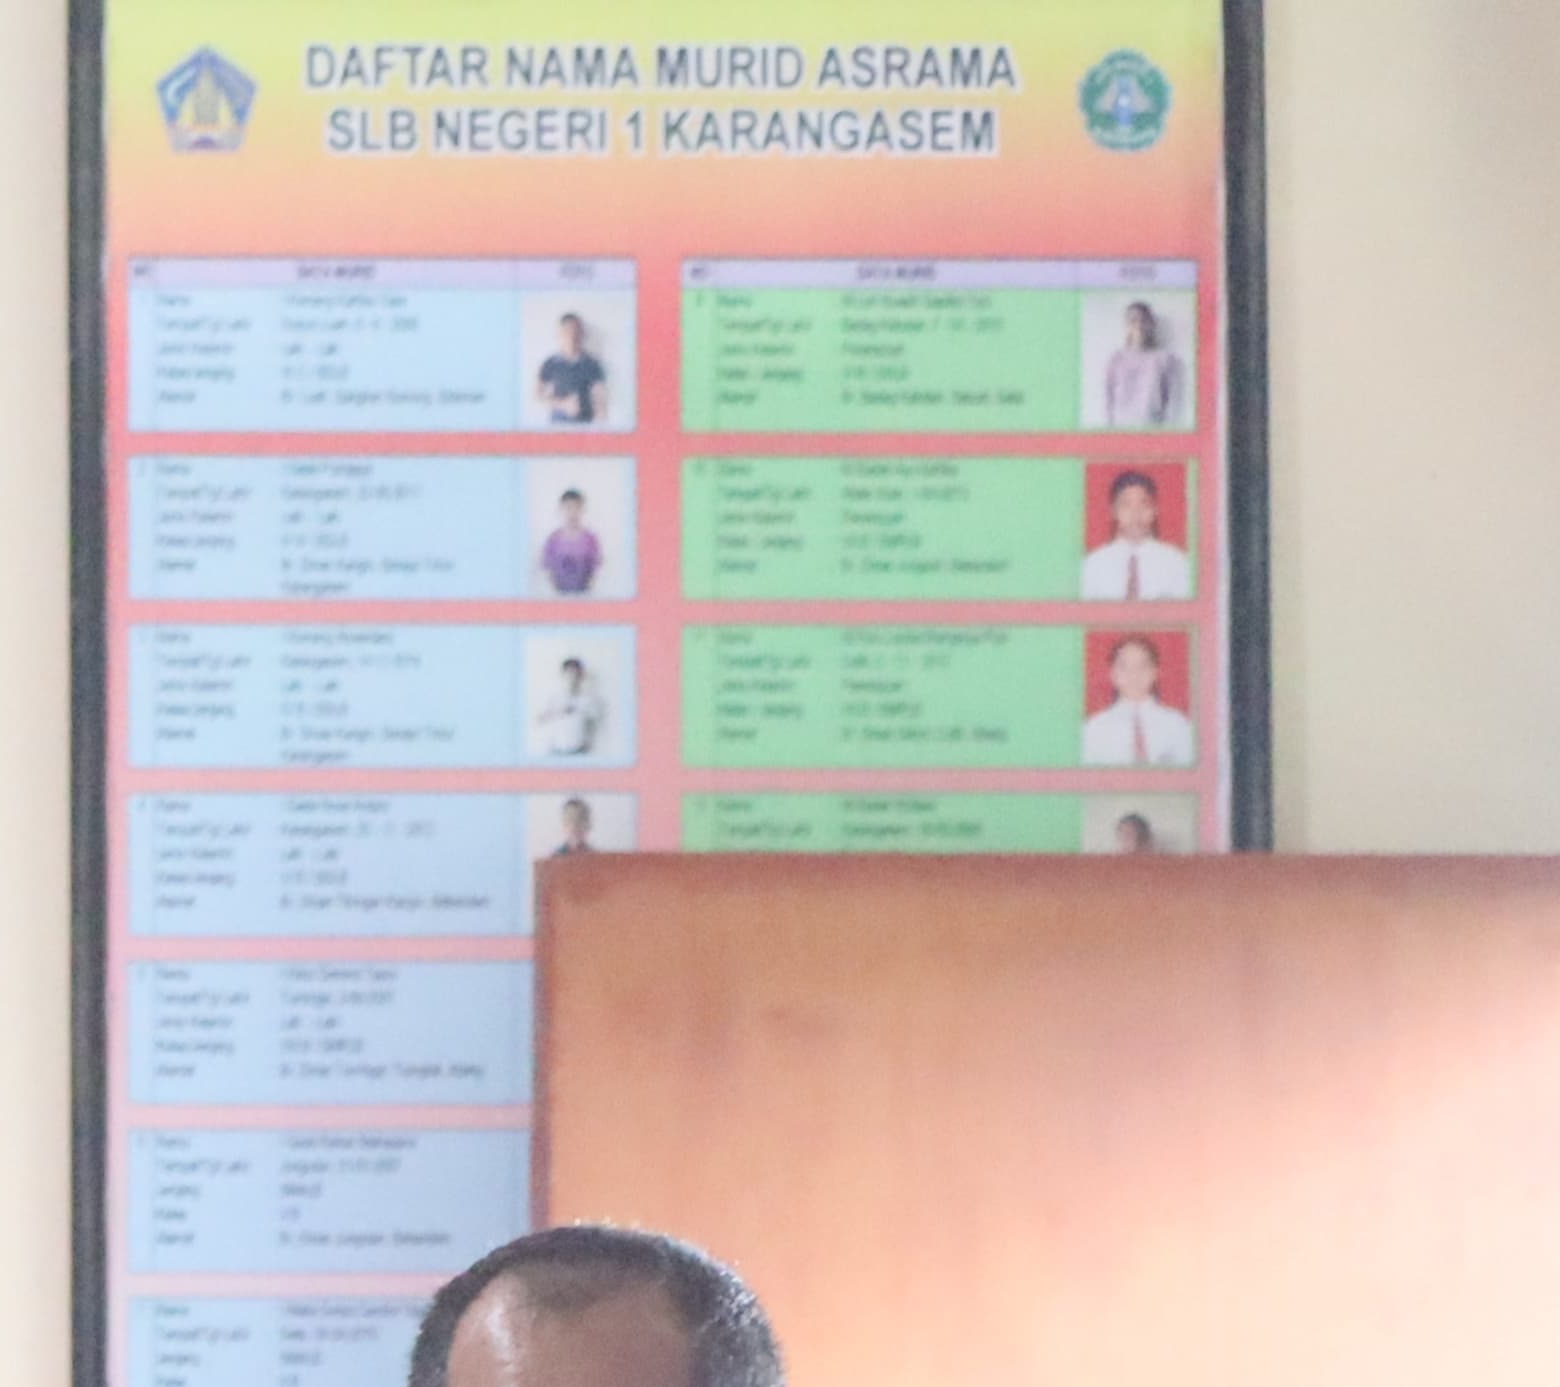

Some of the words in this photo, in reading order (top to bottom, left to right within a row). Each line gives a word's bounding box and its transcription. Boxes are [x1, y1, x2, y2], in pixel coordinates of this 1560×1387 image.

[306, 46, 489, 89] DAFTAR
[506, 46, 640, 89] NAMA
[655, 46, 805, 89] MURID
[817, 46, 1016, 89] ASRAMA
[328, 110, 418, 152] SLB
[433, 110, 608, 152] NEGERI
[627, 110, 643, 150] 1
[662, 110, 996, 152] KARANGASEM
